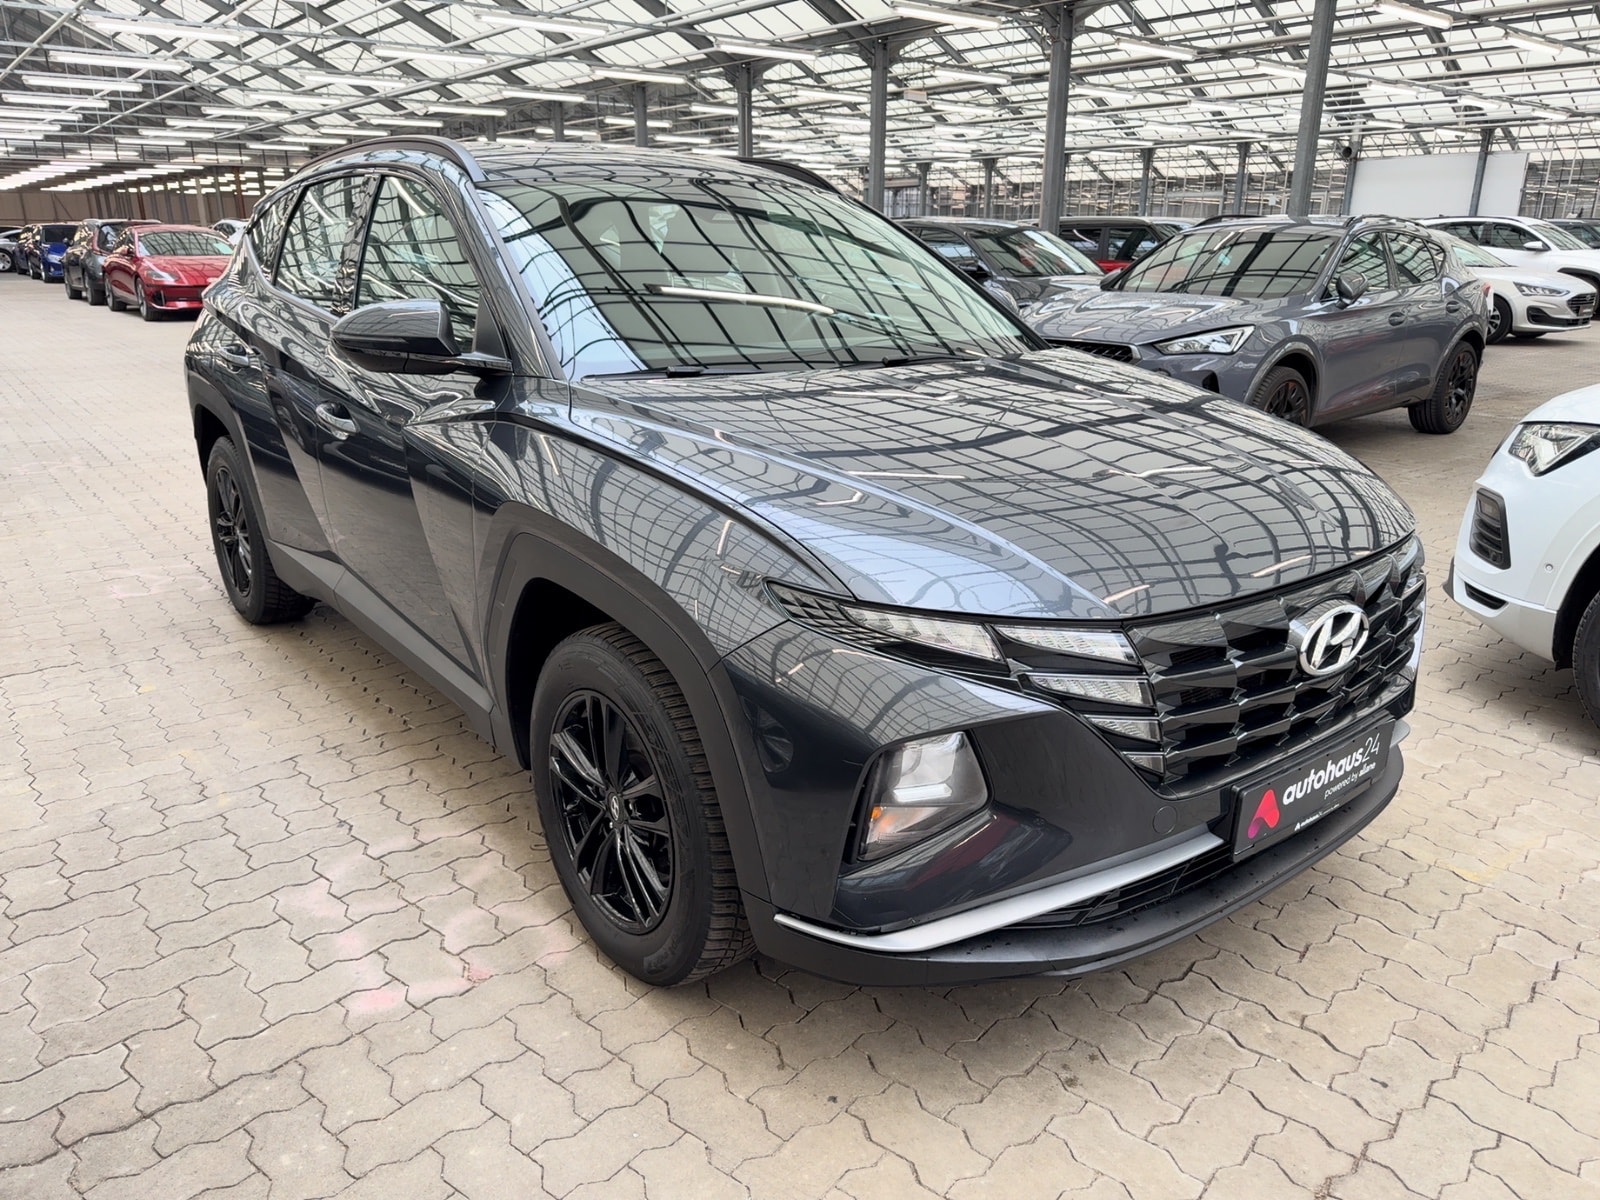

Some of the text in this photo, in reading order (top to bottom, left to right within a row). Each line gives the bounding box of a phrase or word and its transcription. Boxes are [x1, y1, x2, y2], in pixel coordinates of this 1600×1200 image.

[1282, 732, 1380, 806] autohaus24
[1324, 775, 1351, 800] powered
[1351, 771, 1359, 783] by
